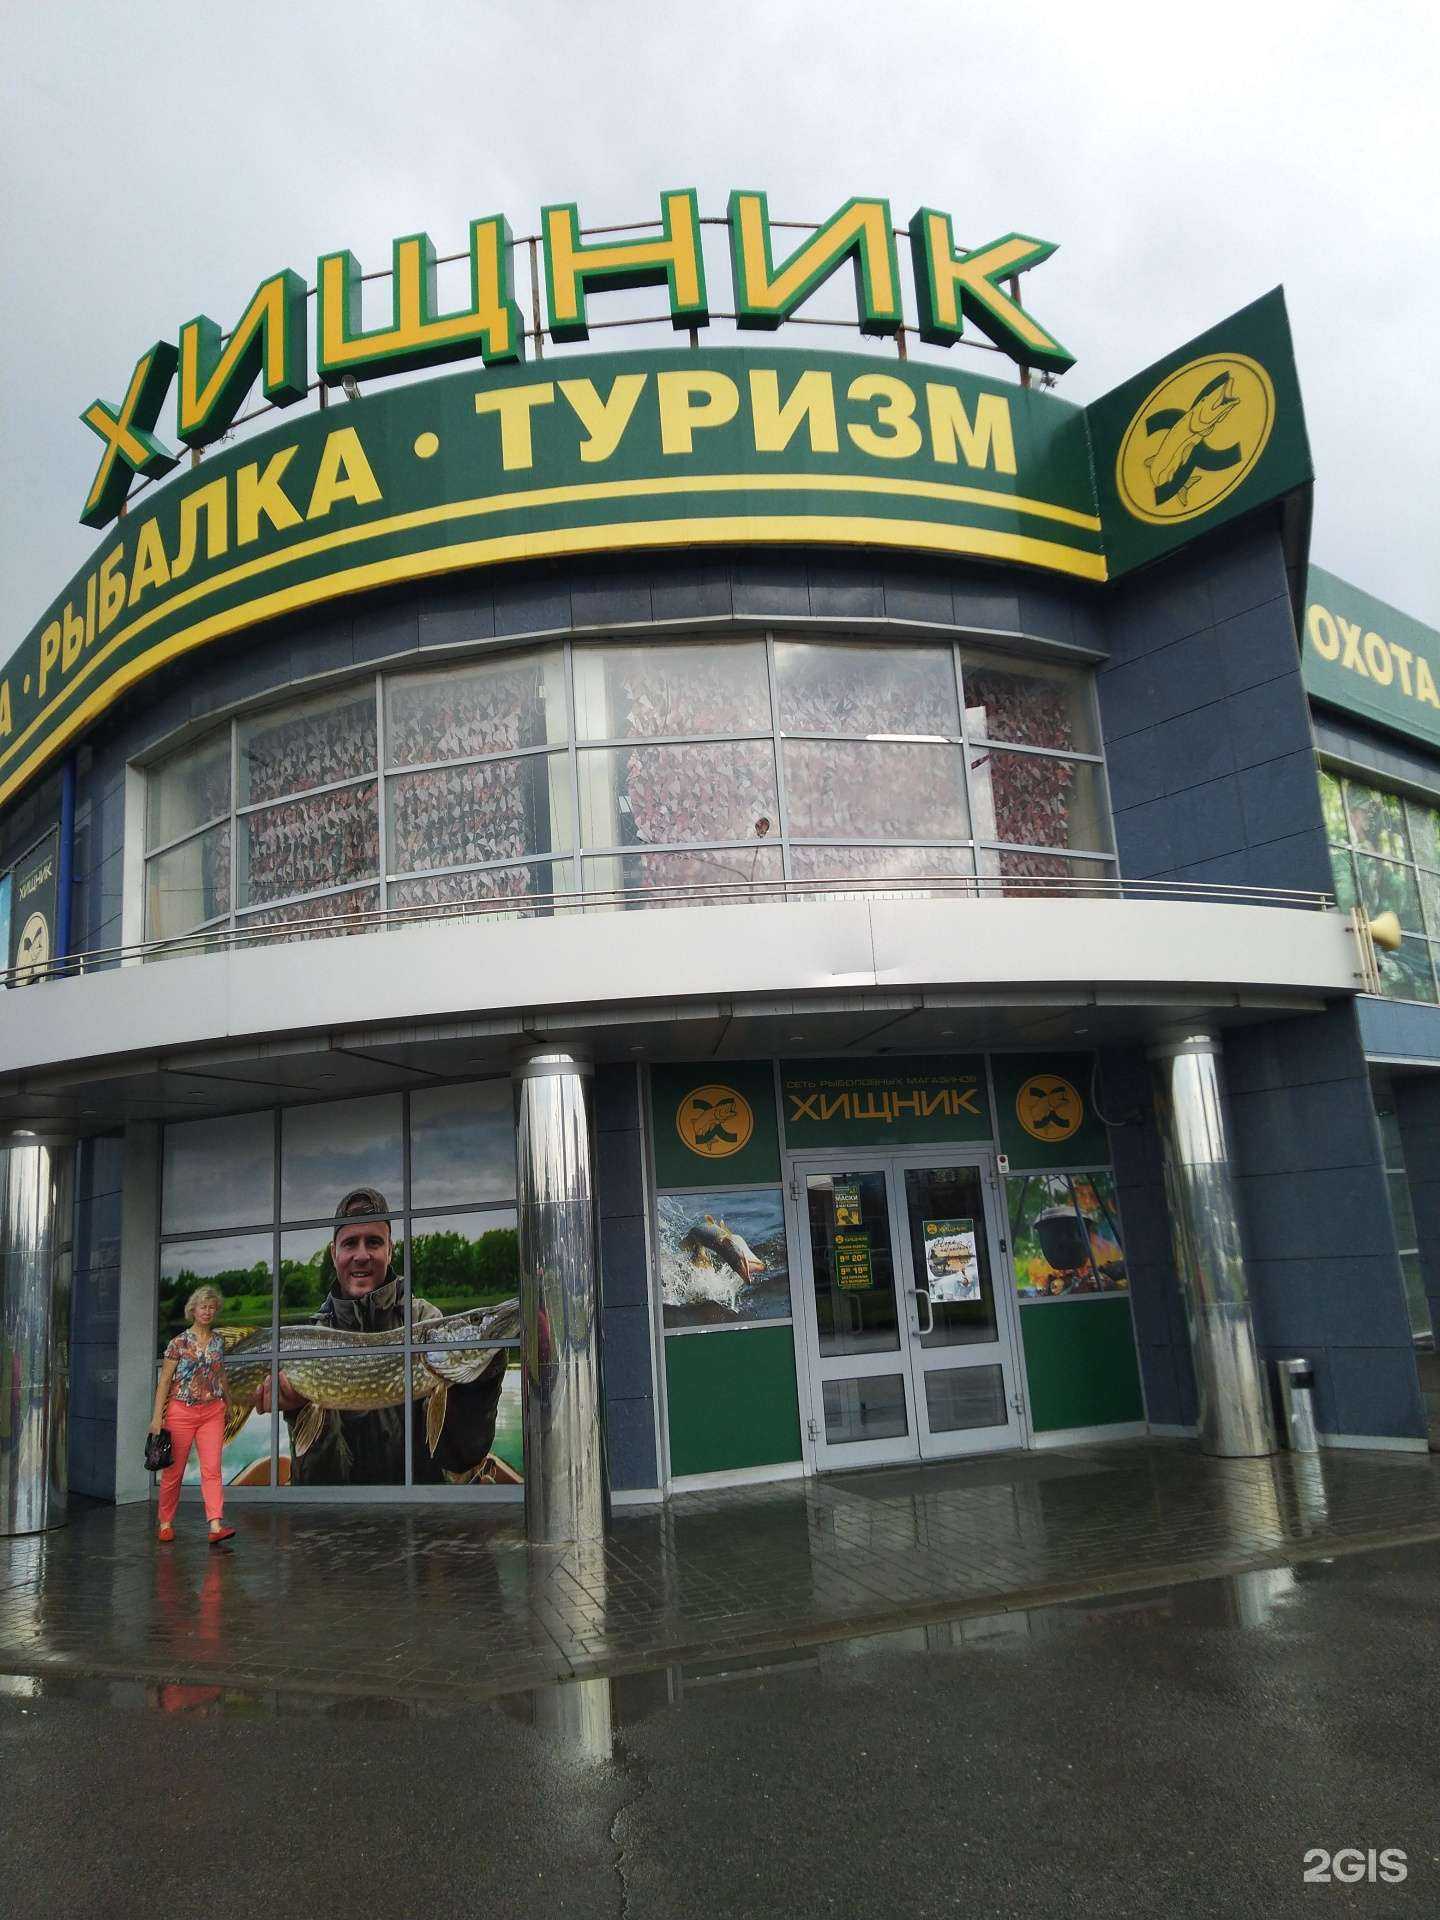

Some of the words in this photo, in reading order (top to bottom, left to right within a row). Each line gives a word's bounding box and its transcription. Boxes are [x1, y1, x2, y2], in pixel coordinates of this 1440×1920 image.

[79, 187, 1077, 529] ХИЩНИК
[38, 426, 383, 698] РЫБАЛКА
[475, 369, 1018, 476] ТУРИЗМ
[1308, 604, 1440, 709] ОХОТА
[788, 1088, 982, 1123] ХИЩНИК
